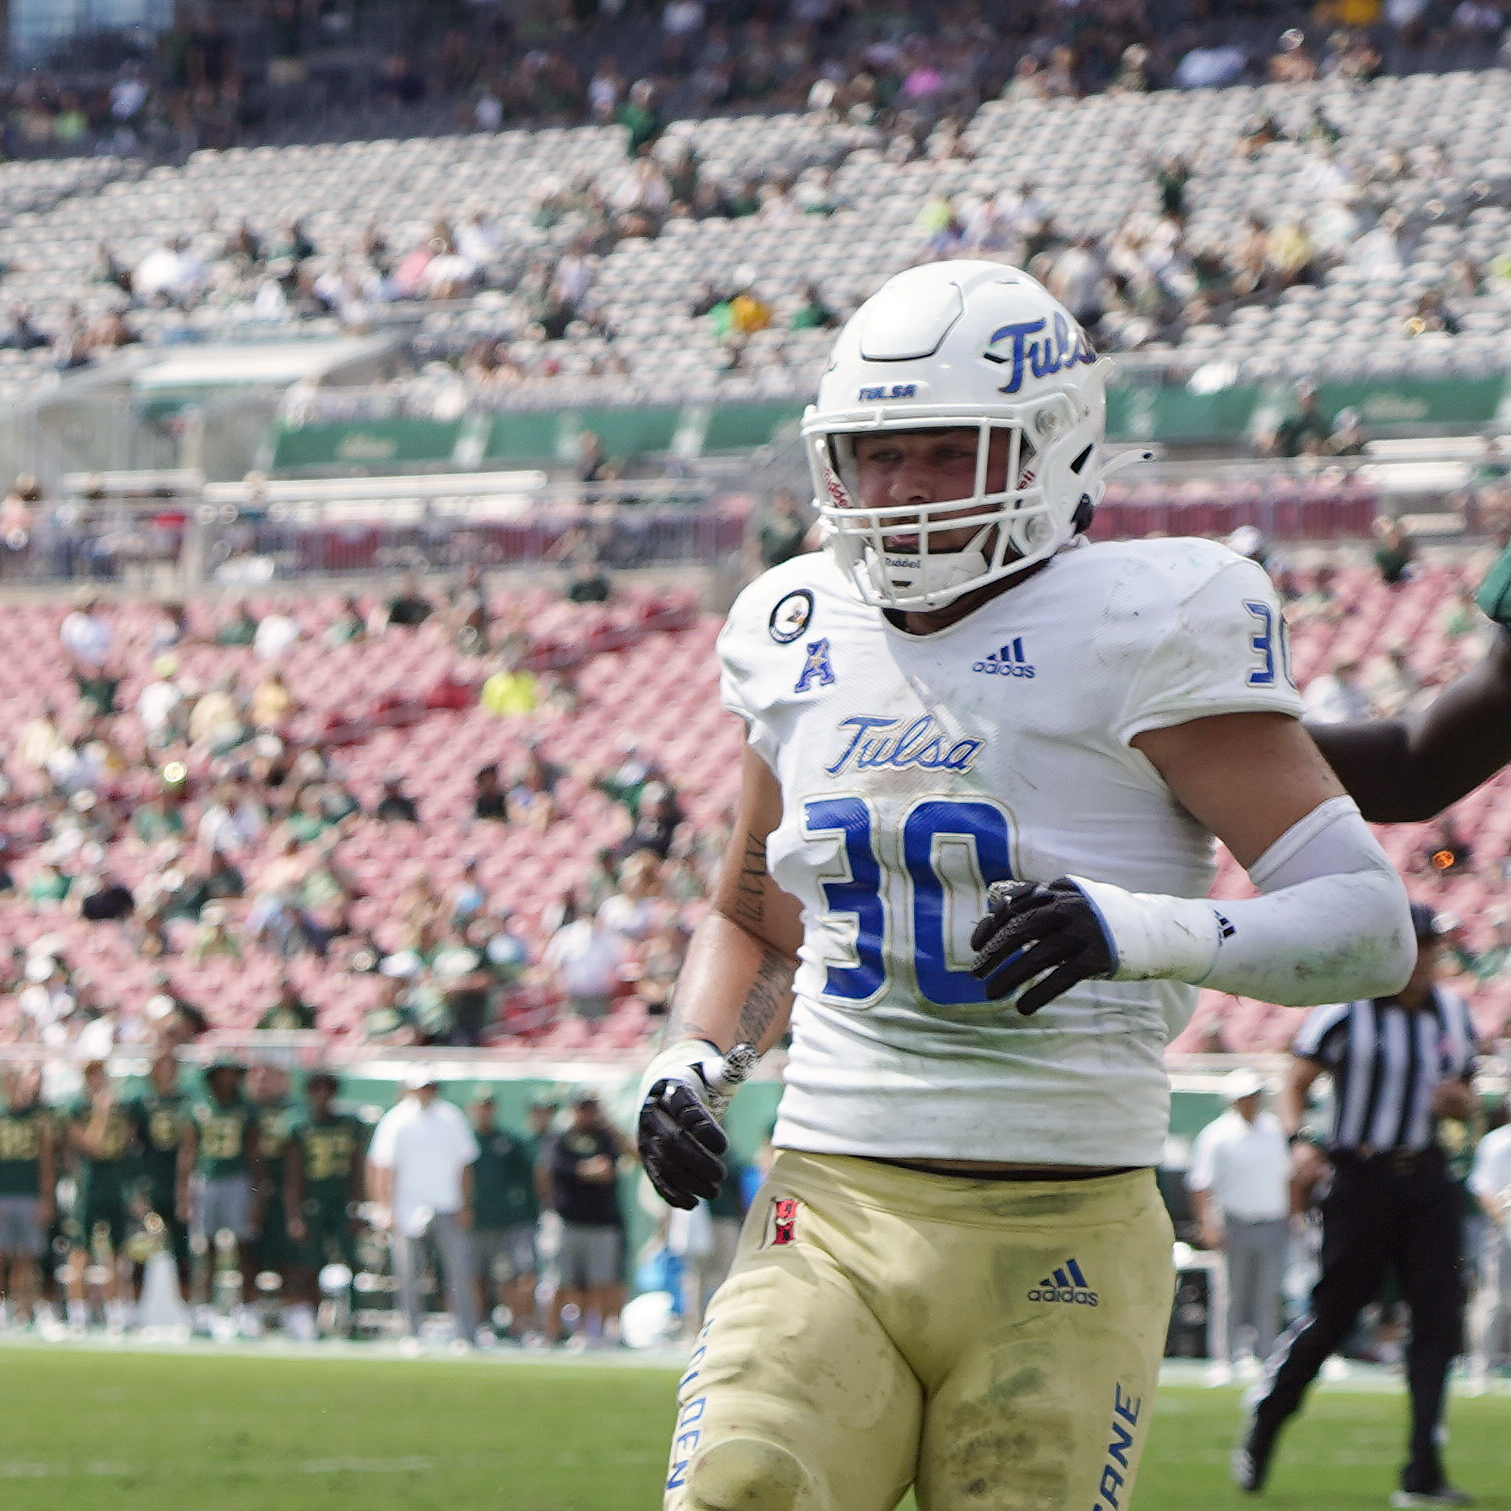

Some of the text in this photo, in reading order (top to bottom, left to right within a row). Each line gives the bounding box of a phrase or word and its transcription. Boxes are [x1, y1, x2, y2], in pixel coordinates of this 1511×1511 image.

[972, 659, 1037, 679] adidas
[826, 713, 985, 778] Tulsa
[800, 792, 1023, 1005] 30
[1027, 1285, 1099, 1307] adidas
